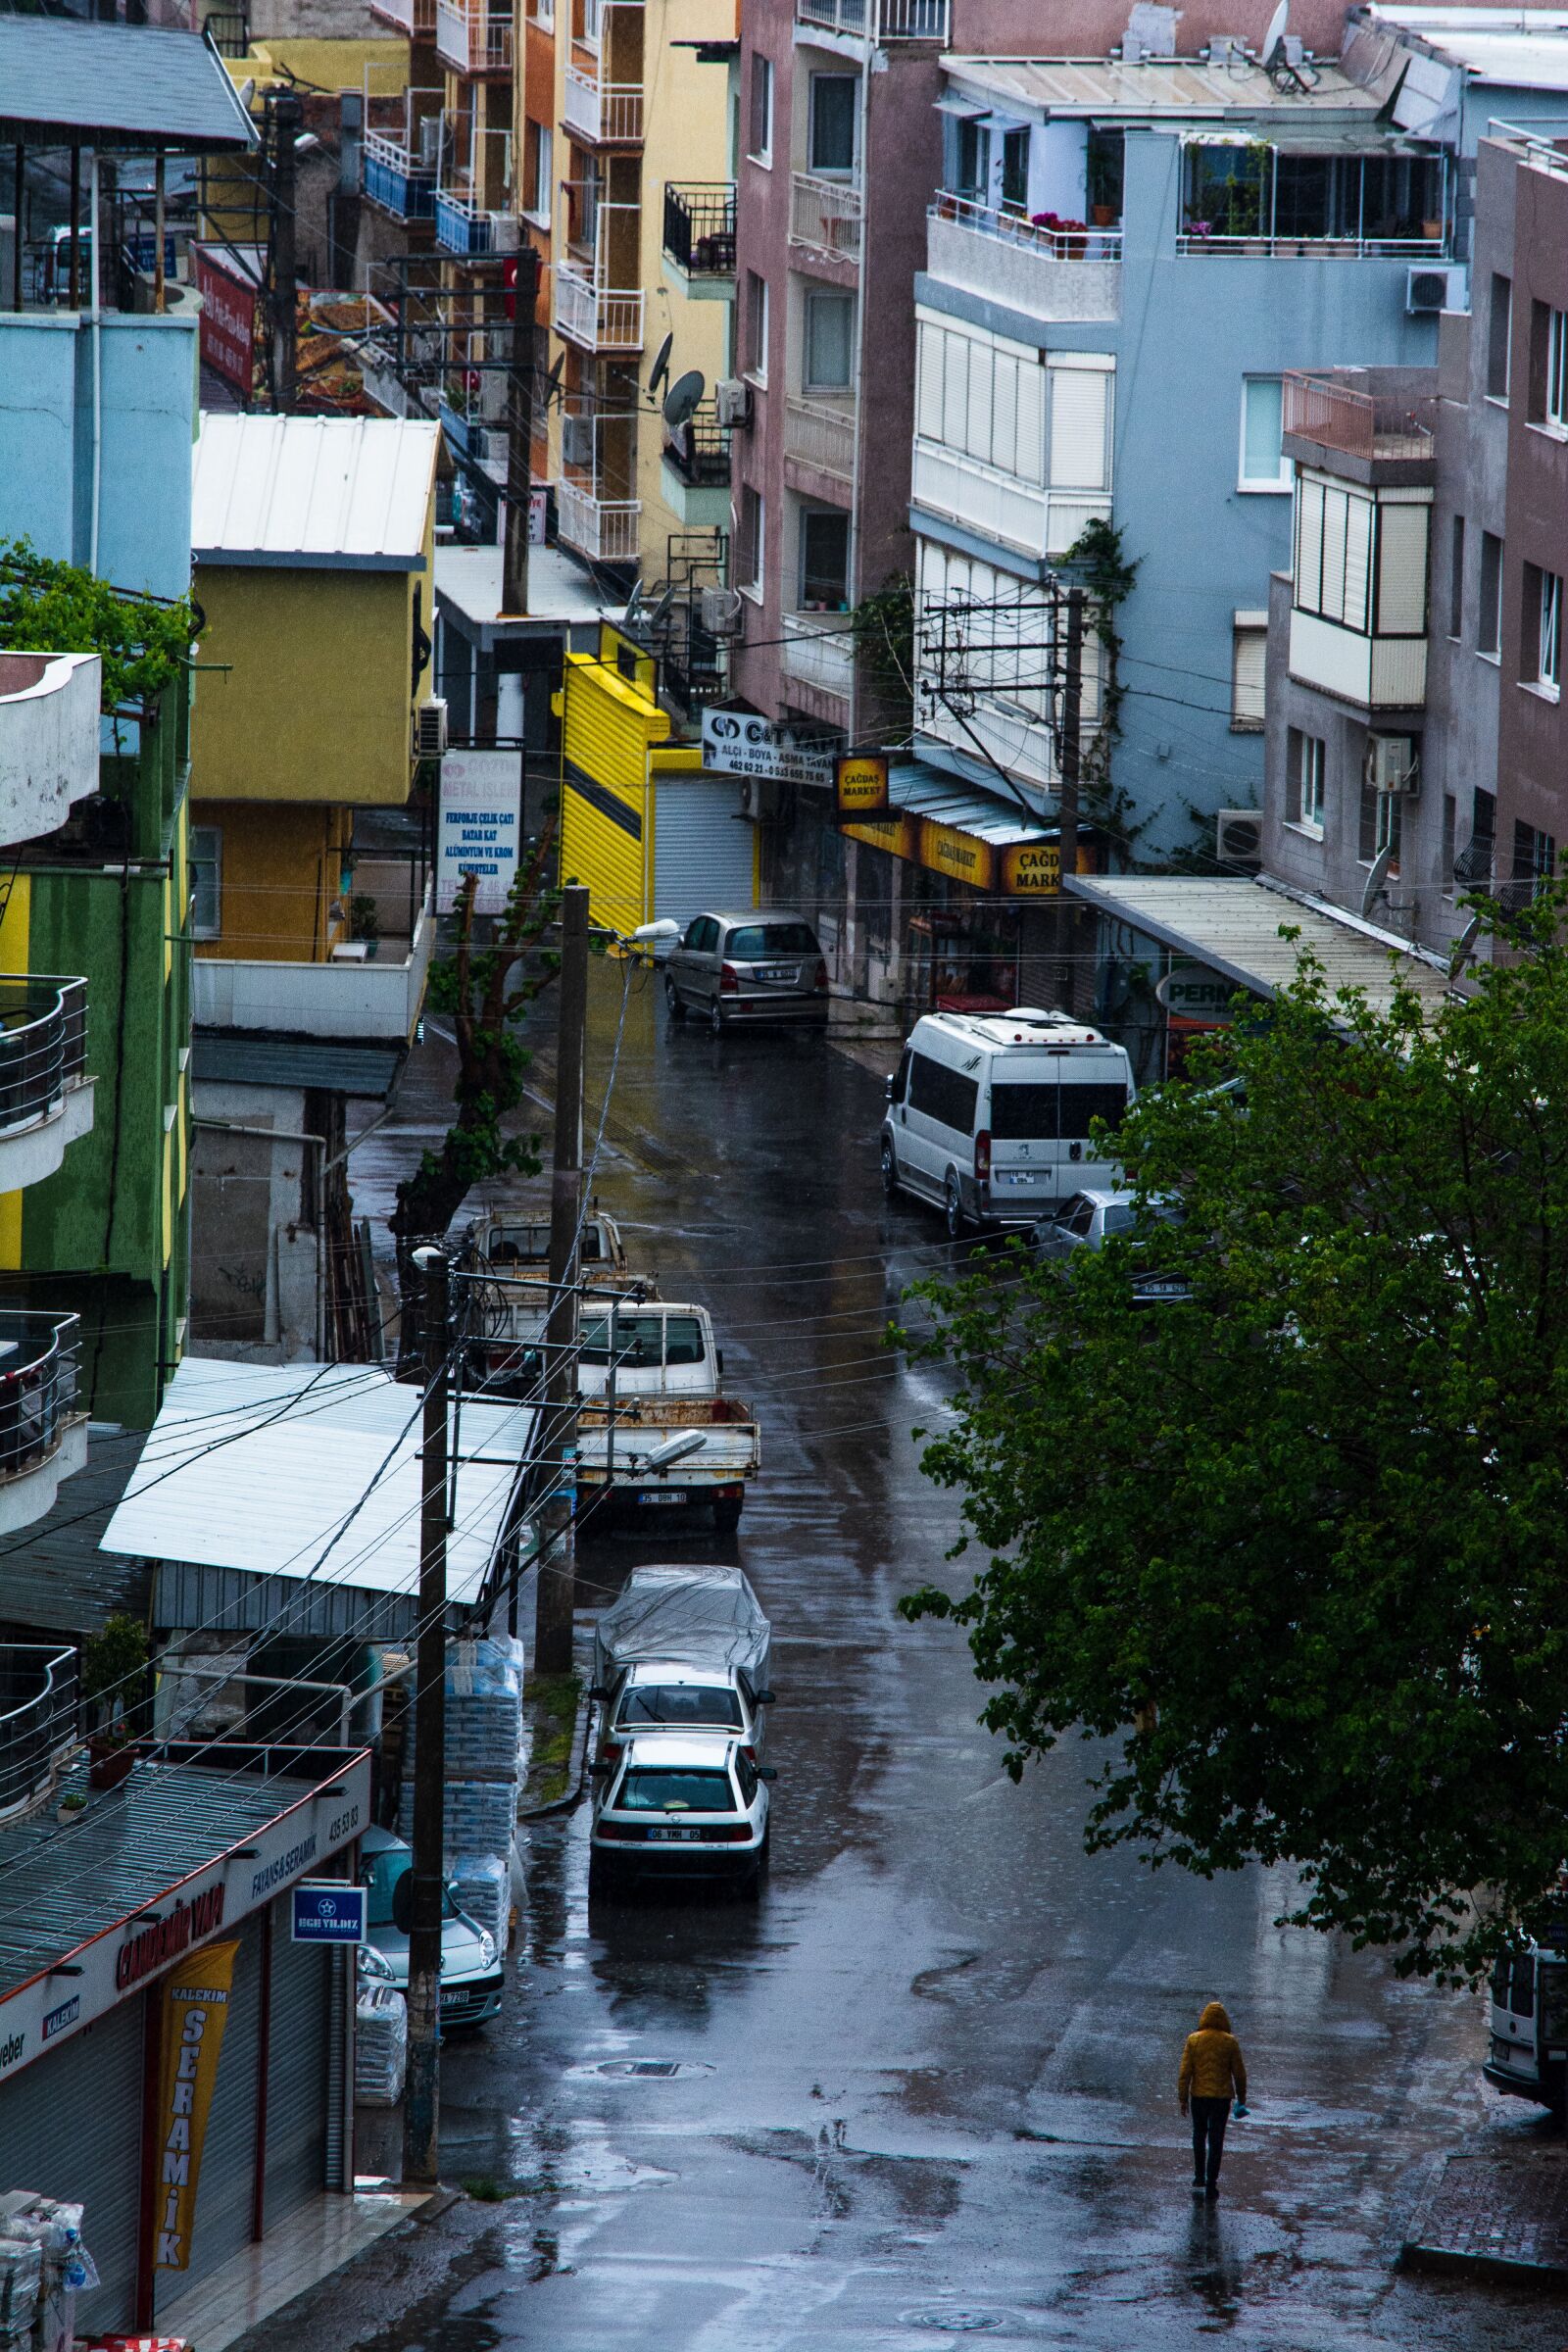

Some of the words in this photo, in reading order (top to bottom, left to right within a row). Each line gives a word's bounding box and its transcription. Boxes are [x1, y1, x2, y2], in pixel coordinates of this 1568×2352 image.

[745, 720, 785, 749] C&T
[749, 749, 772, 760] BOYA
[778, 754, 804, 765] ASMA
[844, 772, 880, 784] ÇAĞDAŞ
[443, 781, 480, 797] METAL
[844, 785, 882, 797] MARKET
[446, 812, 478, 824] FERFORJE
[478, 810, 498, 827] ÇELİK
[499, 813, 514, 828] ÇATI
[462, 830, 483, 841] BATAR
[483, 830, 497, 841] KAT
[485, 847, 493, 858] VE
[494, 847, 514, 858] KROM
[1019, 850, 1059, 870] ÇAĞD
[1016, 873, 1059, 887] MARK
[643, 1494, 652, 1502] 35
[676, 1494, 685, 1502] 10
[653, 1829, 662, 1838] 06
[298, 1918, 322, 1929] EGE
[322, 1918, 359, 1930] YILDIZ
[157, 2007, 207, 2267] SERAMİK
